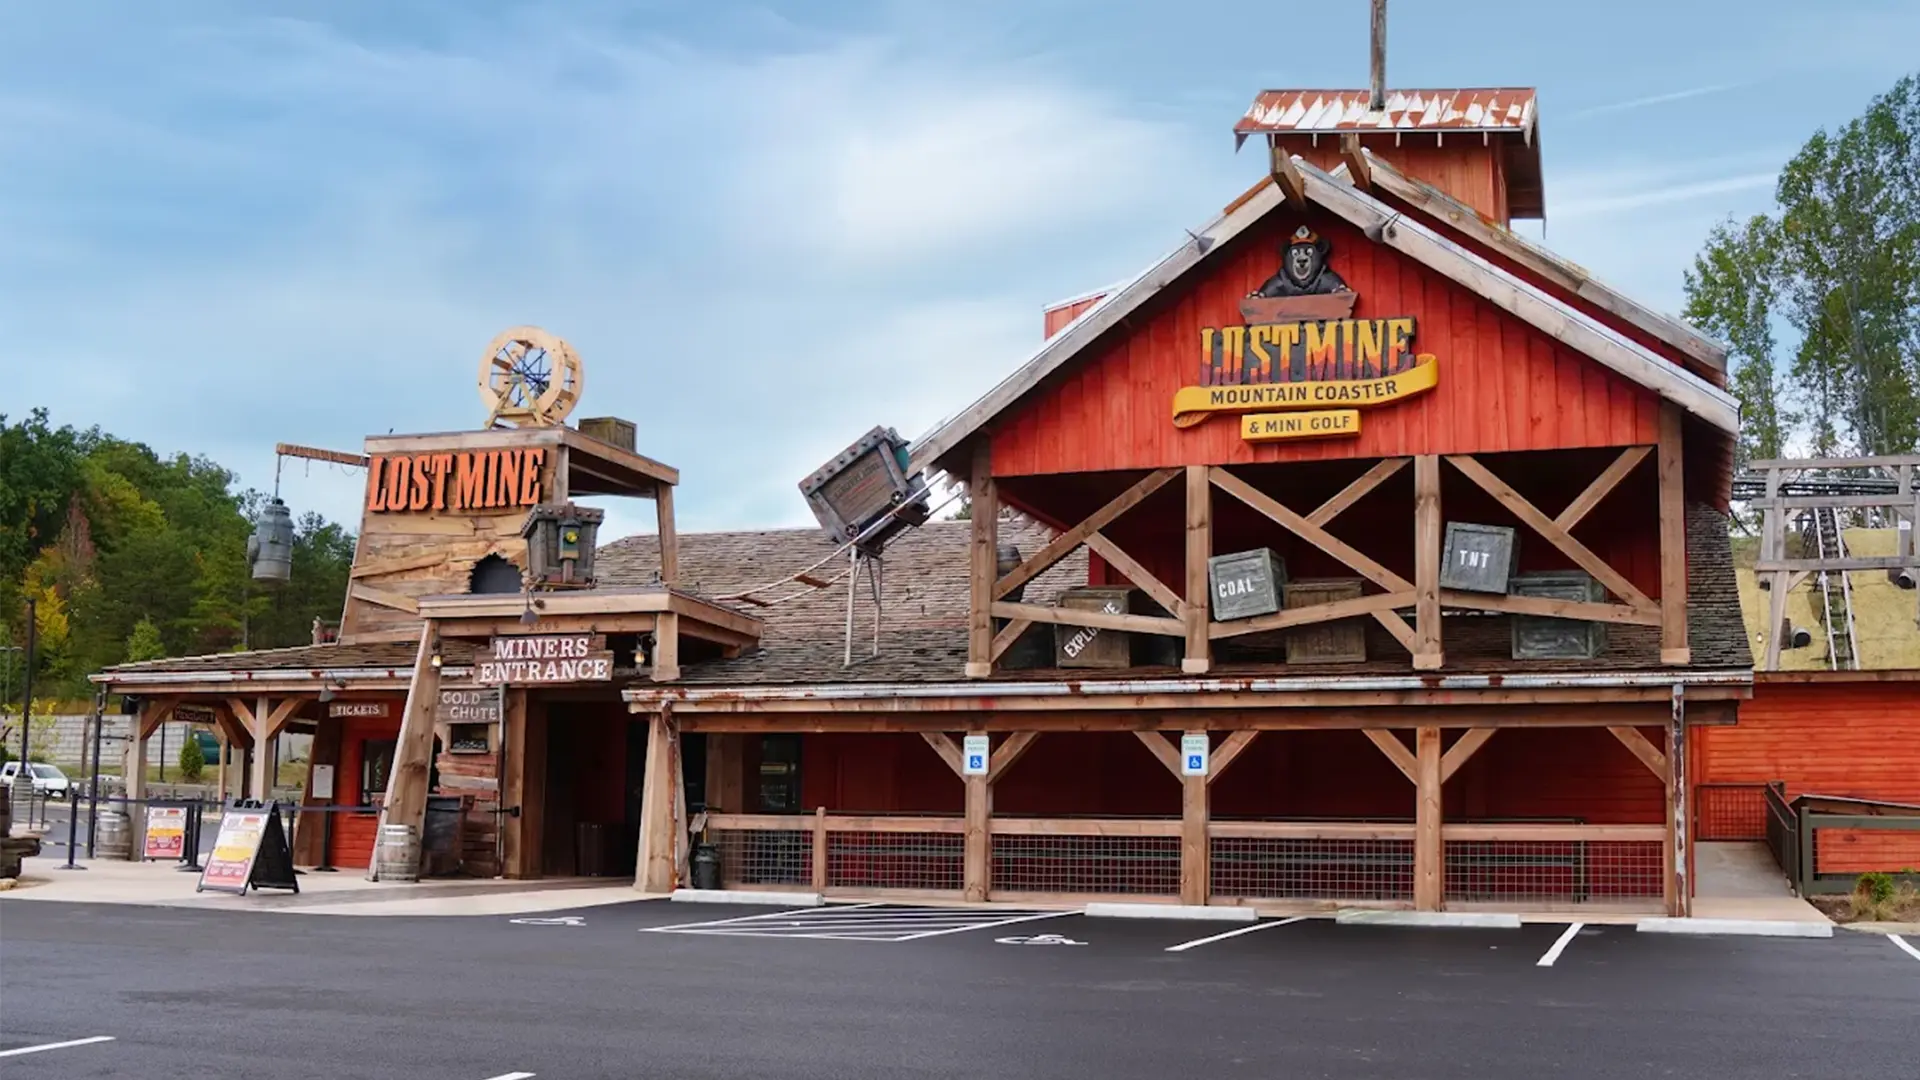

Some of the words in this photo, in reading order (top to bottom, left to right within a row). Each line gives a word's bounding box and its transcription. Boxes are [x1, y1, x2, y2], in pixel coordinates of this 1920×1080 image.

[1200, 322, 1300, 386] LOST
[1303, 318, 1415, 384] MINE
[1210, 386, 1308, 405] MOUNTAIN
[1314, 380, 1398, 401] COASTER
[1249, 422, 1260, 434] &
[1265, 419, 1302, 433] MINI
[1310, 415, 1350, 431] GOLF
[368, 454, 452, 511] LOST
[454, 449, 545, 509] MINE
[1459, 549, 1491, 569] TNT
[1218, 580, 1255, 599] COAL
[494, 637, 590, 660] MINERS
[479, 659, 609, 684] ENTRANCE
[442, 691, 481, 706] GOLD
[336, 704, 380, 716] TICKETS
[450, 706, 498, 720] CHUTE
